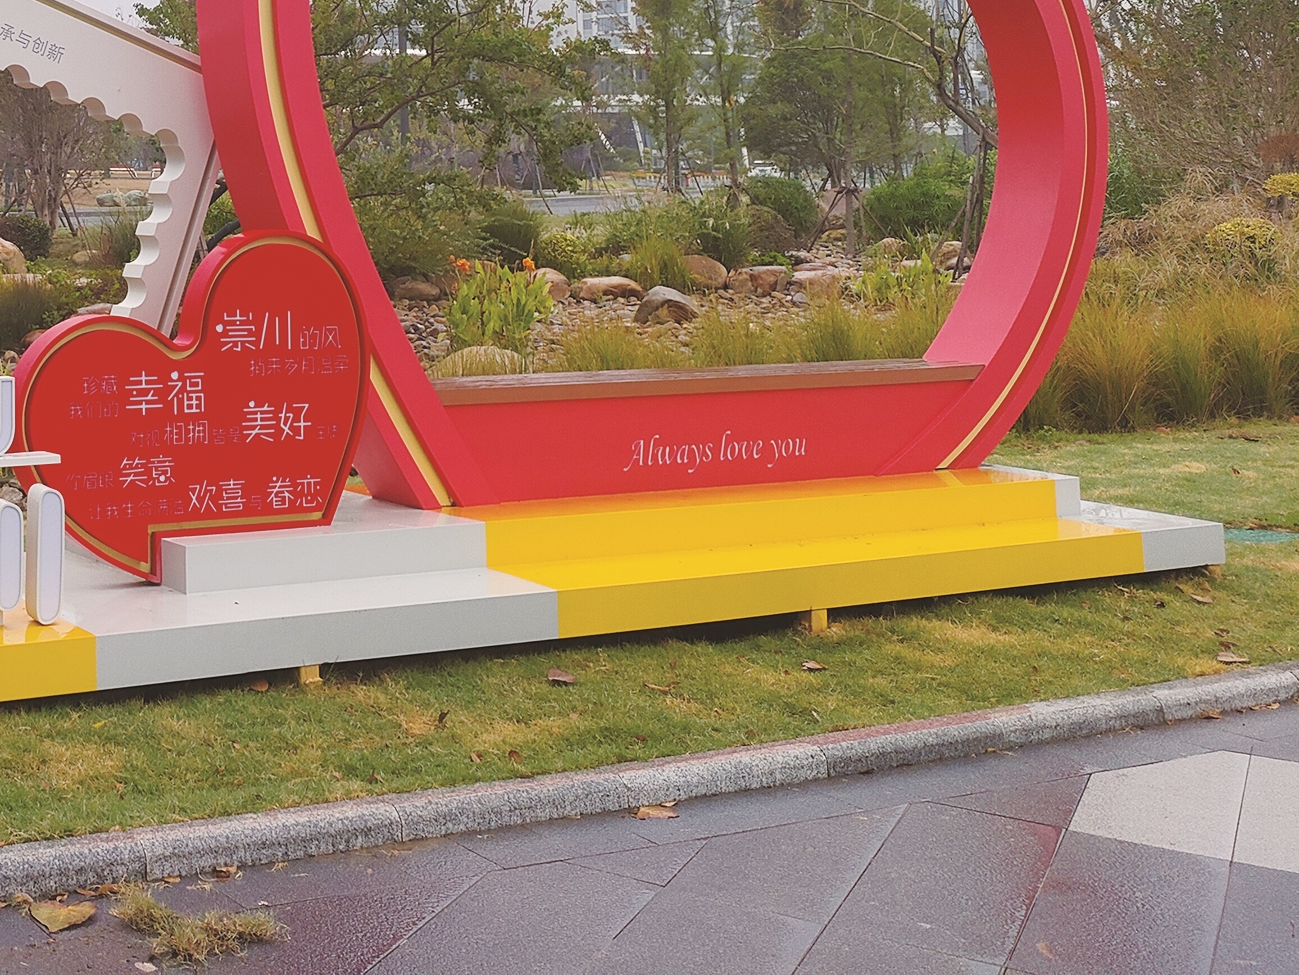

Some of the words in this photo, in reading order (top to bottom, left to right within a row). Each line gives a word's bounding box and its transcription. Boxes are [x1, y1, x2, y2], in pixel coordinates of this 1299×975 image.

[623, 435, 713, 473] Always
[720, 431, 763, 461] love
[767, 437, 806, 467] you
